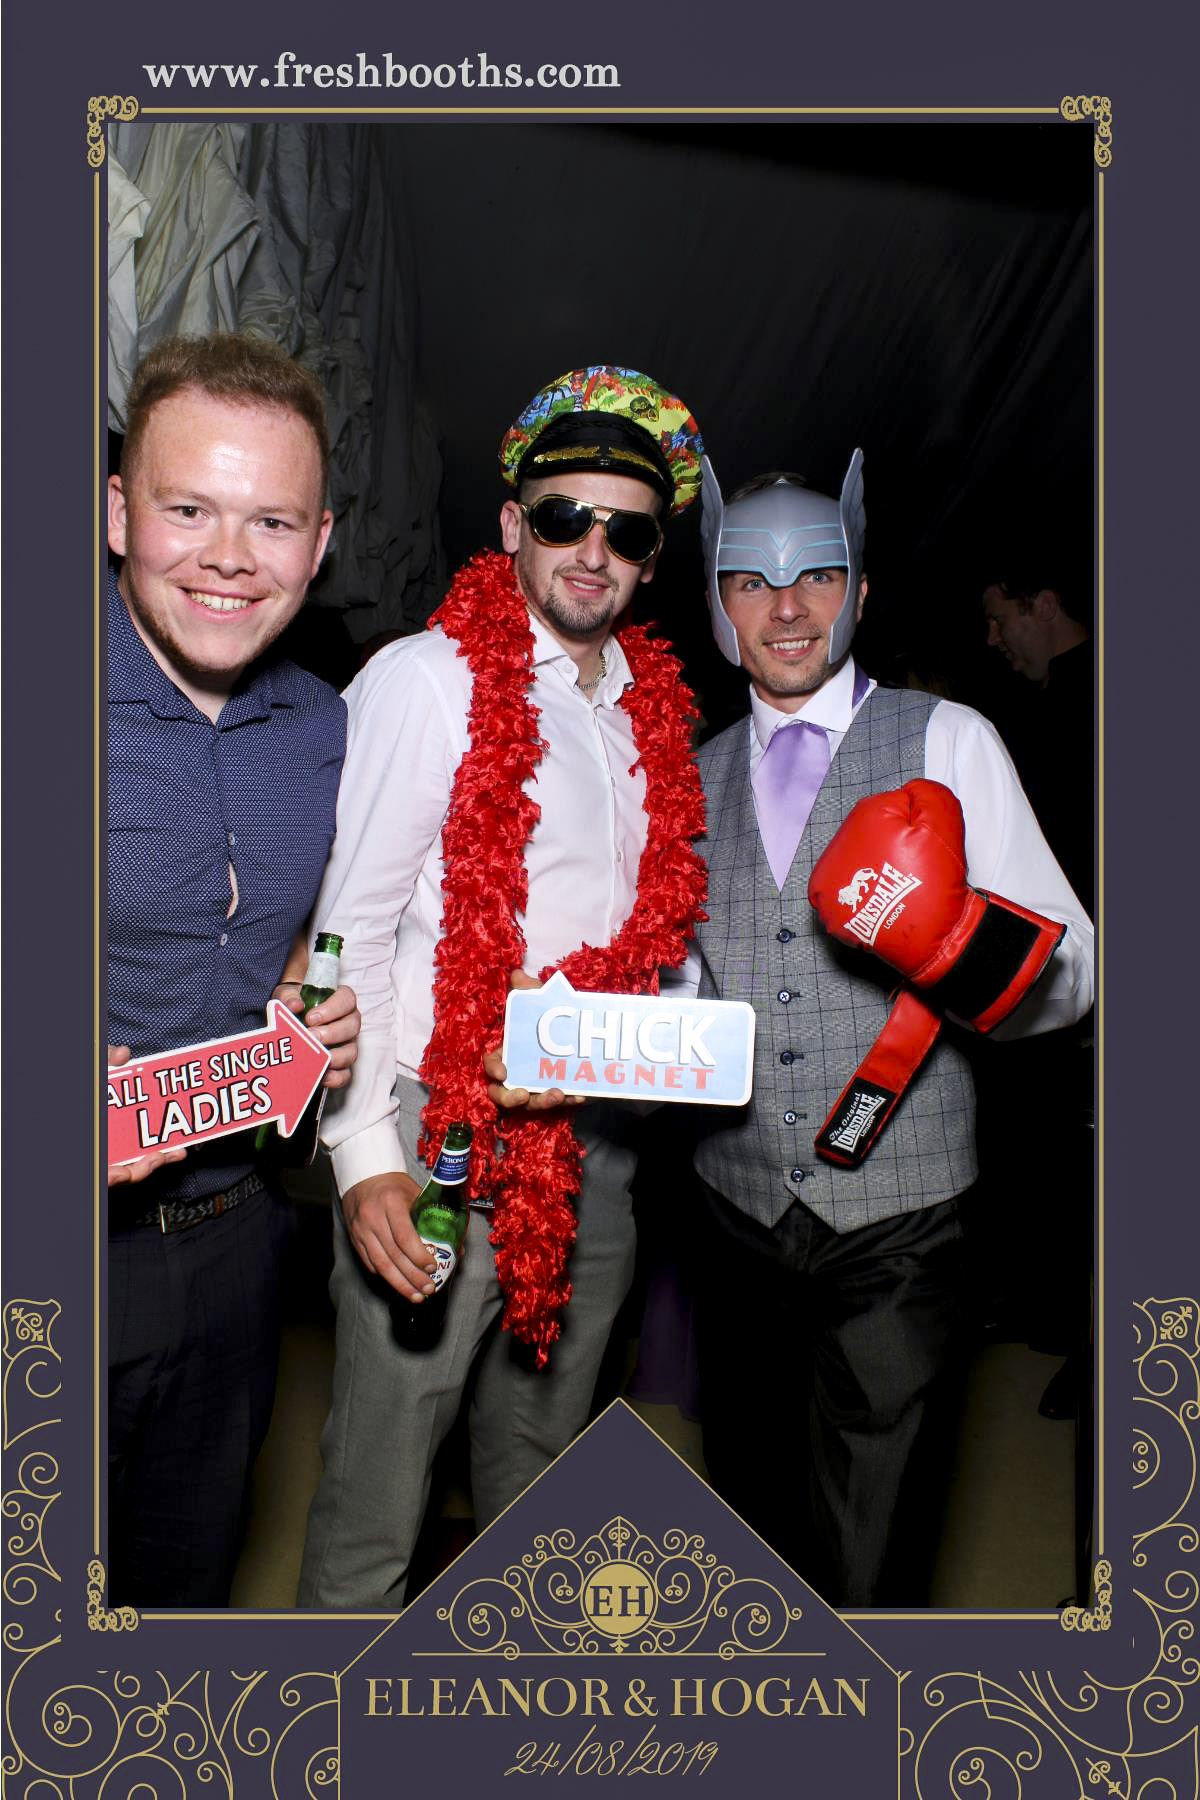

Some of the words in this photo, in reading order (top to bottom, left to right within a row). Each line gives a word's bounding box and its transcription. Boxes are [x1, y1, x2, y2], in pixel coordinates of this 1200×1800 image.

[843, 861, 922, 947] LONSDALE
[883, 903, 907, 930] LONDON
[537, 1006, 717, 1066] CHICK
[154, 1060, 204, 1097] THE
[208, 1037, 292, 1081] SINGLE
[538, 1057, 715, 1089] MAGNET
[137, 1075, 272, 1148] LADIES
[830, 1092, 888, 1154] LONSDALE
[841, 1092, 862, 1127] Original
